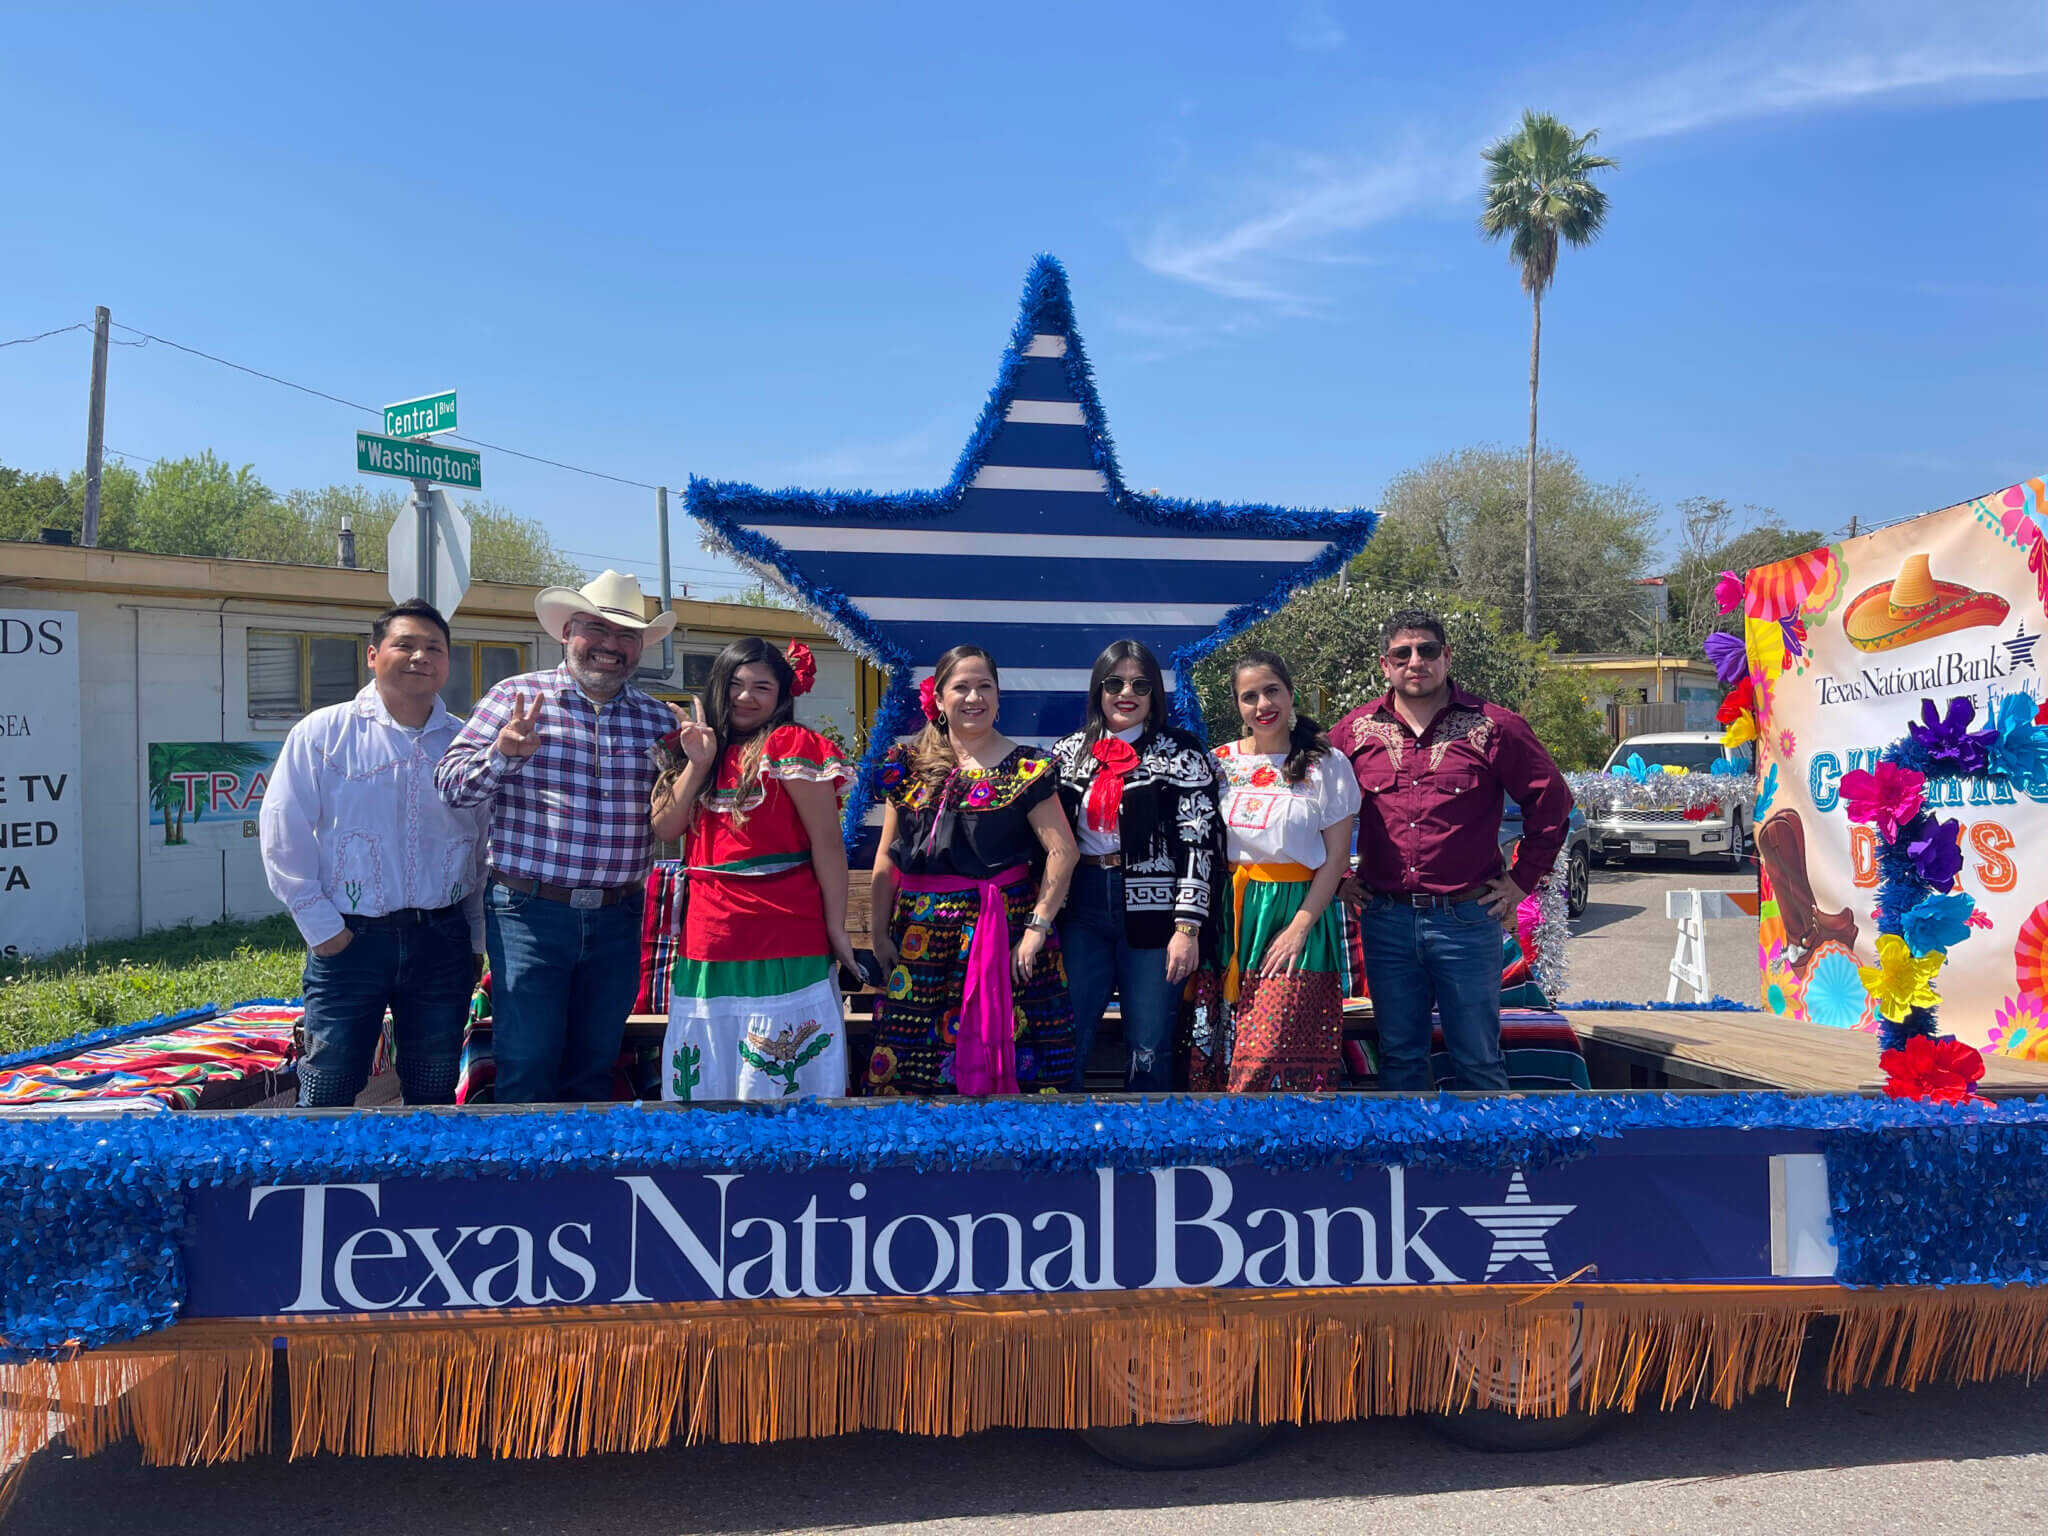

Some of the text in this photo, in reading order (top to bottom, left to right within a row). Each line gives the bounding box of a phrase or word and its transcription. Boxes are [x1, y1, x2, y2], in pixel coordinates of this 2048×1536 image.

[387, 400, 455, 437] Central Blvd
[358, 439, 480, 481] W Washington St
[1815, 644, 2006, 705] Texas National Bank
[19, 774, 68, 802] TV
[249, 1164, 1467, 1312] Texas National Bank
